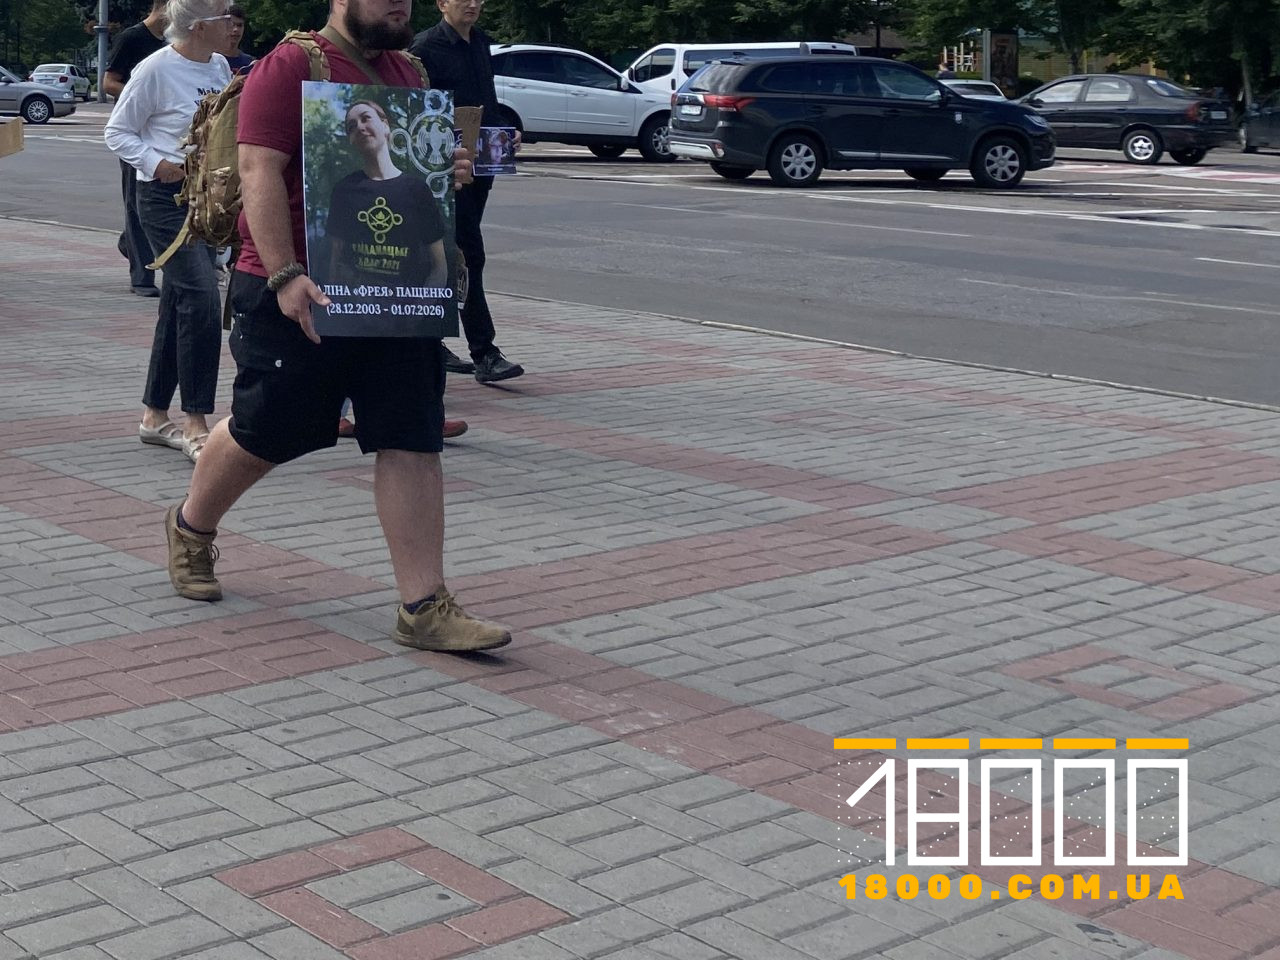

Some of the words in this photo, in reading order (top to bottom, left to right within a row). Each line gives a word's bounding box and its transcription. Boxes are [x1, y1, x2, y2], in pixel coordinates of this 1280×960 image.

[353, 285, 393, 297] «ФРЕЯ»
[396, 286, 453, 299] ПАЩЕНКО
[327, 303, 381, 316] (28.12.2003
[391, 305, 445, 318] 01.07.2026)
